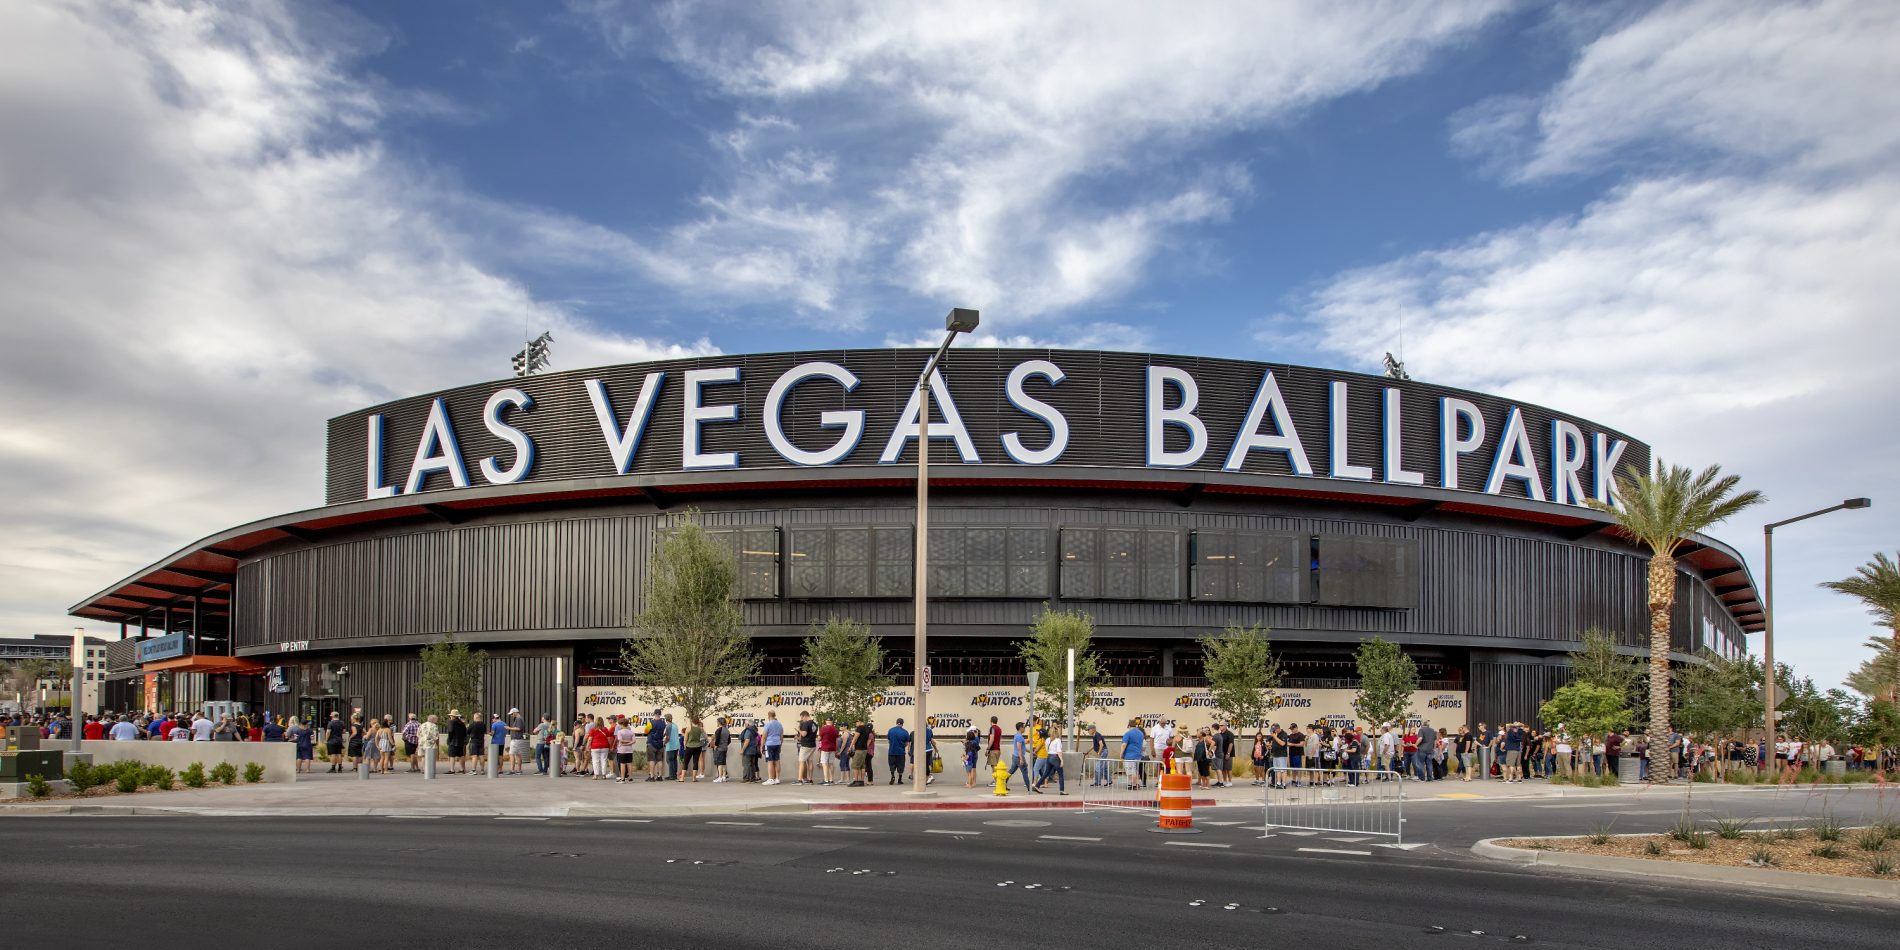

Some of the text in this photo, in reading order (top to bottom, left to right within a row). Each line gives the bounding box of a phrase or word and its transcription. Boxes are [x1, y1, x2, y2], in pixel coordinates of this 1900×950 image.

[367, 355, 1630, 508] LAS VEGAS BALLPARK
[280, 640, 309, 652] VIP ENTRY
